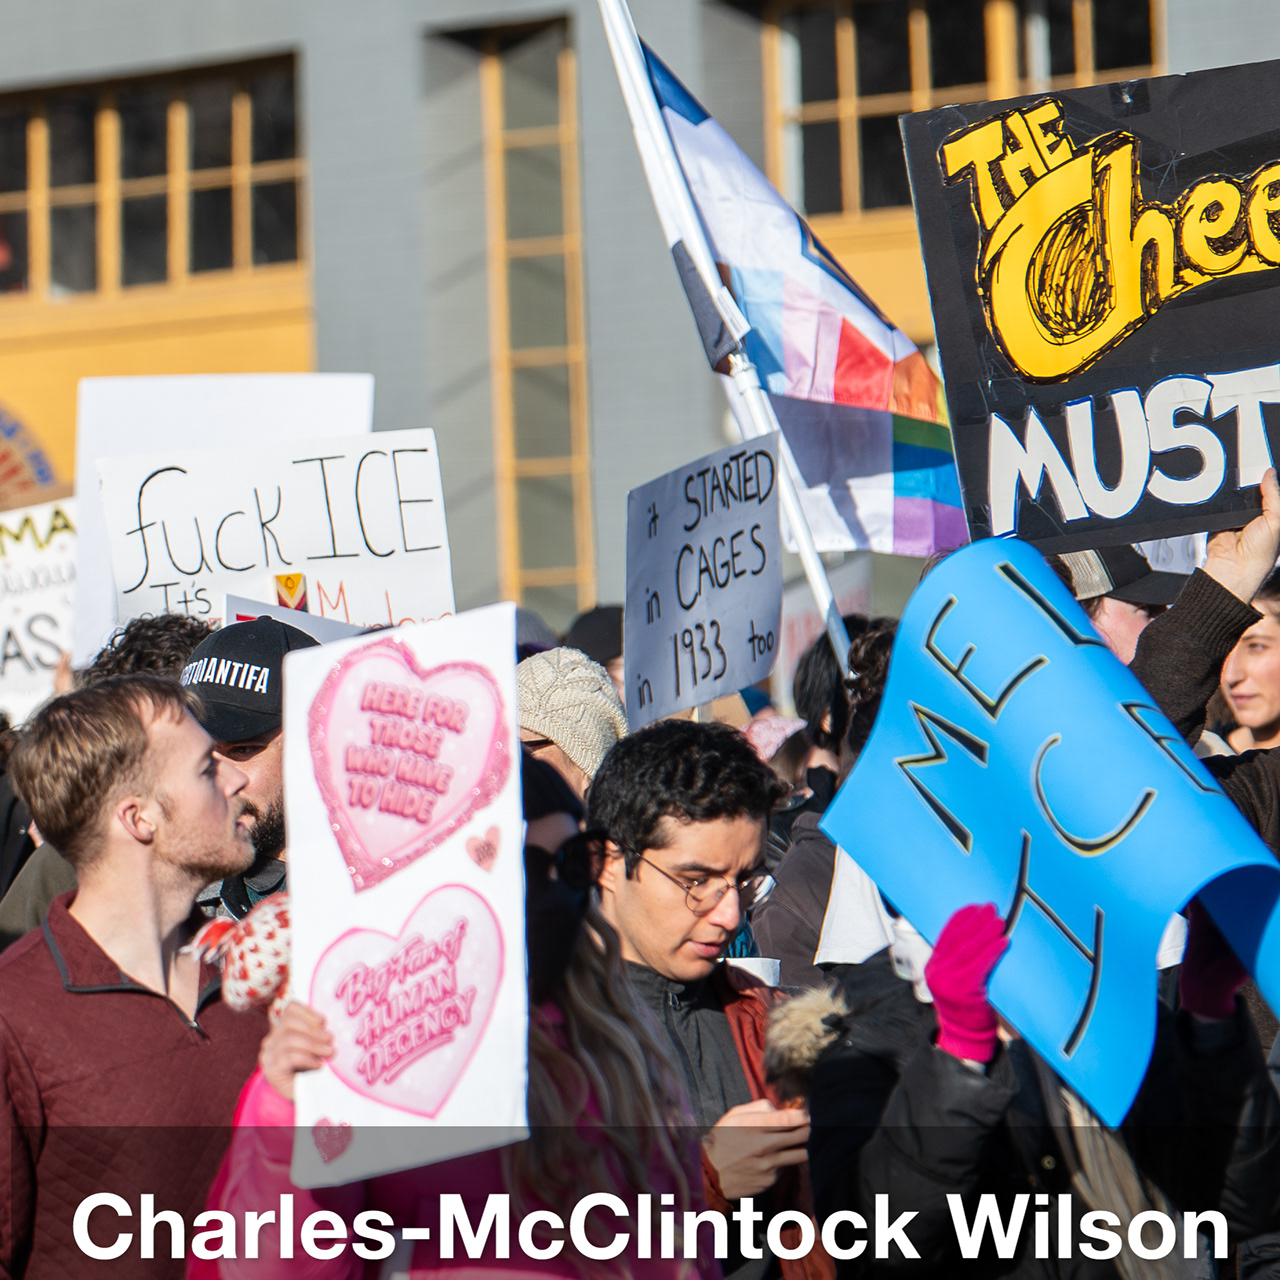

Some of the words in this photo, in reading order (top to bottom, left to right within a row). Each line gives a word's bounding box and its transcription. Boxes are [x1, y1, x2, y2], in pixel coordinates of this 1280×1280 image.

[938, 97, 1075, 230] THE
[648, 502, 660, 540] it
[684, 449, 776, 532] STARTED
[988, 362, 1280, 540] MUST
[292, 449, 442, 561] ICE
[646, 587, 662, 625] in
[676, 523, 767, 612] CAGES
[360, 680, 424, 721] HERE
[422, 695, 471, 736] FOR
[638, 674, 654, 710] in
[673, 619, 728, 700] 1933
[748, 619, 775, 664] too
[345, 741, 396, 777] WHO
[395, 752, 455, 796] HAVE
[369, 715, 445, 760] THOSE
[348, 775, 382, 810] TO
[378, 779, 440, 826] HIDE
[355, 963, 458, 1050] HUMAN
[356, 985, 477, 1086] DECENCY
